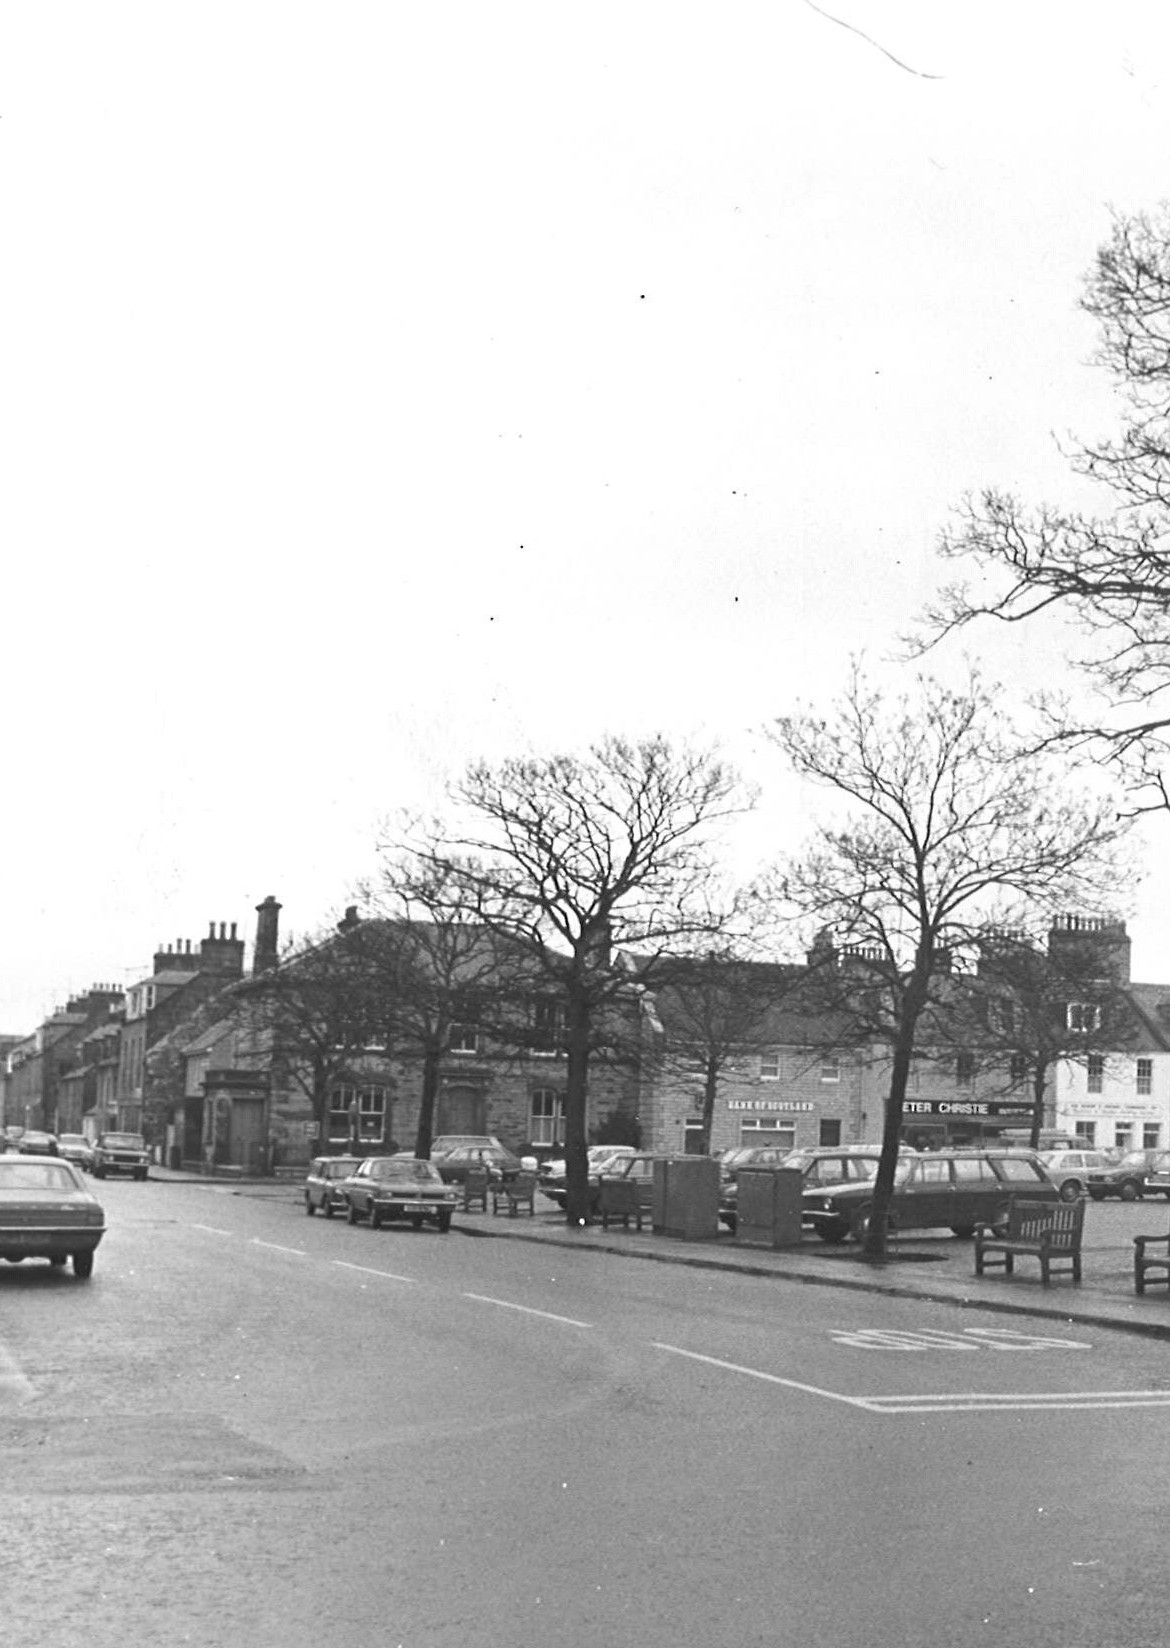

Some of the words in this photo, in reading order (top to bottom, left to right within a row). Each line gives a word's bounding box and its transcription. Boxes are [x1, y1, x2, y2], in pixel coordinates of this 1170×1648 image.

[728, 1100, 753, 1110] BANK
[902, 1101, 932, 1113] ETER
[938, 1102, 989, 1114] CHRISTIE
